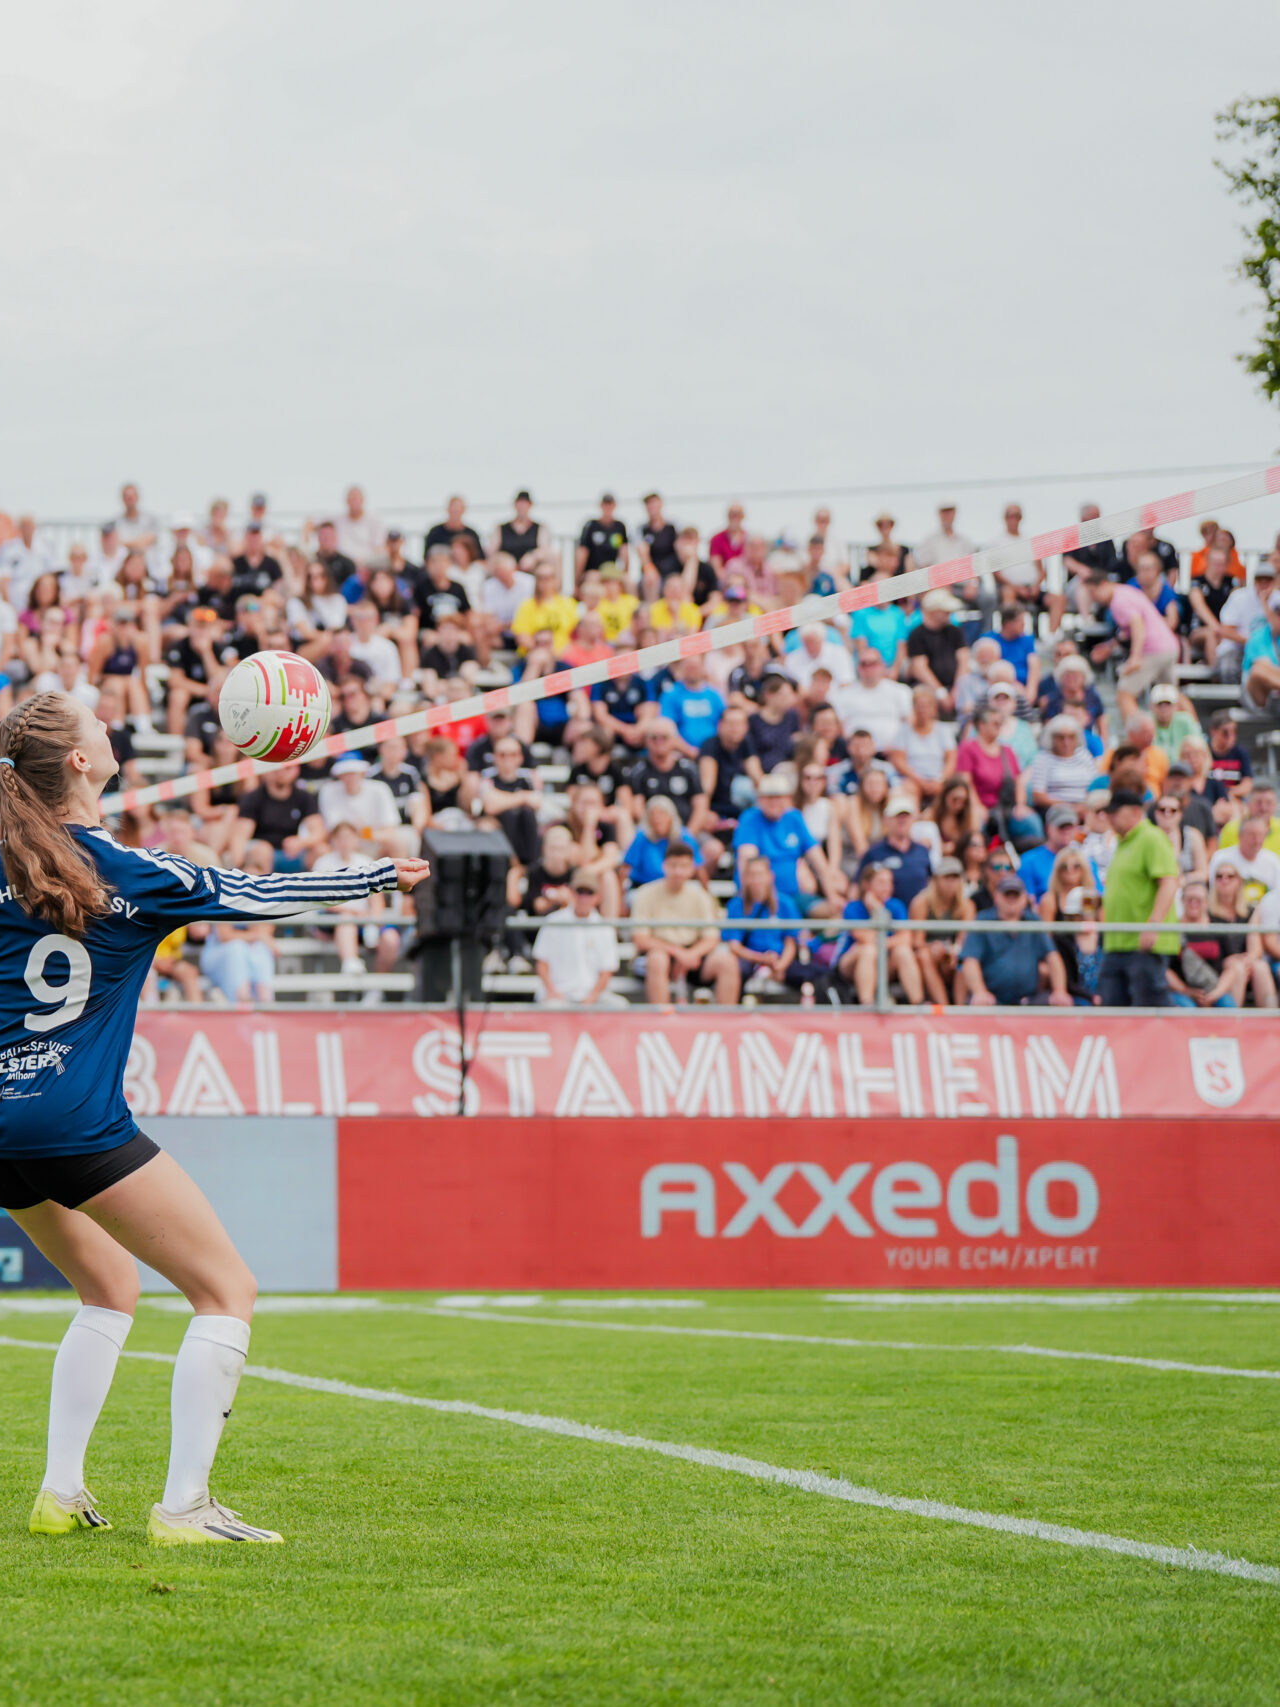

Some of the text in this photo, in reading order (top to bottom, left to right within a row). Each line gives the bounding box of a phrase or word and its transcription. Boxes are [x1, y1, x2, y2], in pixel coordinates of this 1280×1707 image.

[110, 896, 140, 919] SV
[23, 933, 93, 1032] 9
[412, 1029, 1120, 1118] STAMMHEIM
[885, 1246, 950, 1270] YOUR
